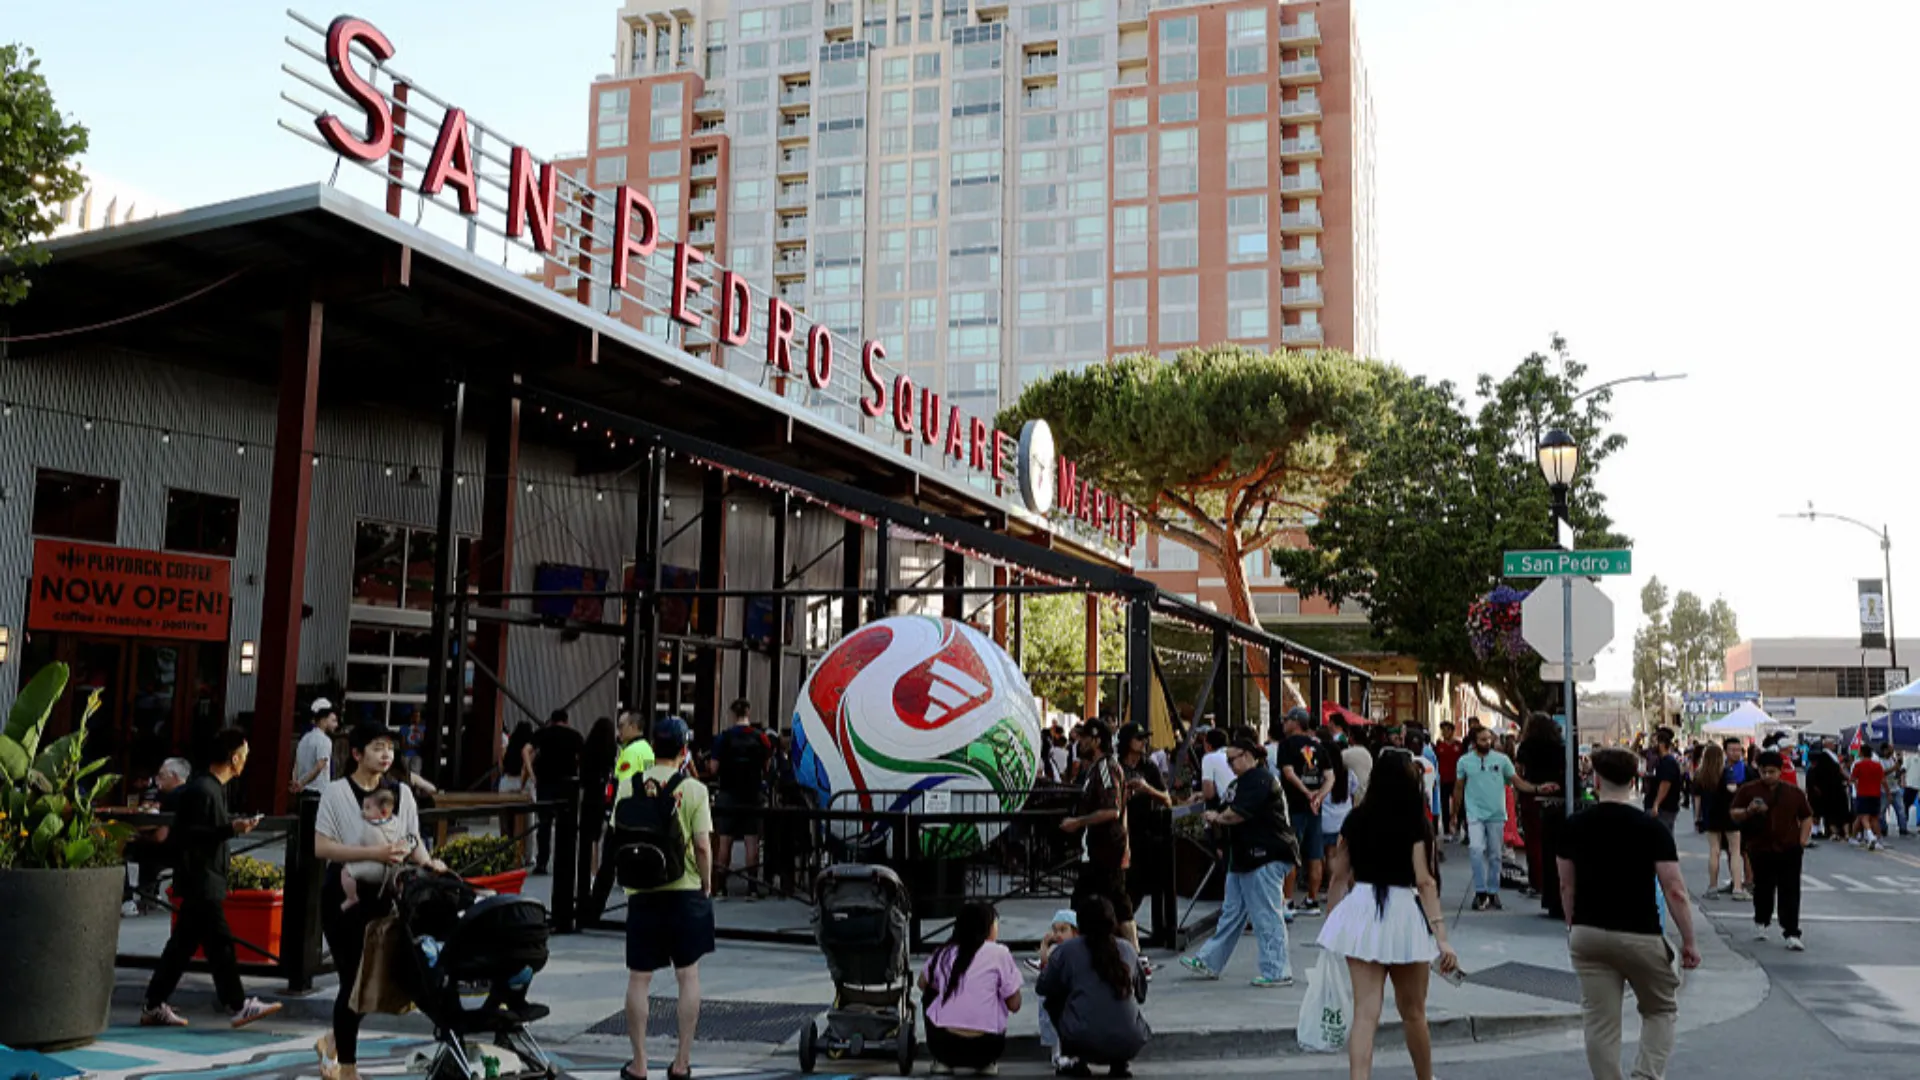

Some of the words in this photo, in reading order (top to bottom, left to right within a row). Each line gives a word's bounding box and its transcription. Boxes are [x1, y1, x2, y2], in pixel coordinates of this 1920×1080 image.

[314, 15, 556, 251] SAN
[612, 185, 833, 389] PEDRO
[860, 340, 1006, 482] SQUARE
[88, 553, 163, 577] PLAYBACK
[166, 561, 212, 582] COFFEE
[1521, 556, 1554, 572] San
[1558, 555, 1610, 571] Pedro
[40, 575, 125, 606] NOW
[133, 585, 223, 615] OPEN!
[53, 611, 95, 623] coffee
